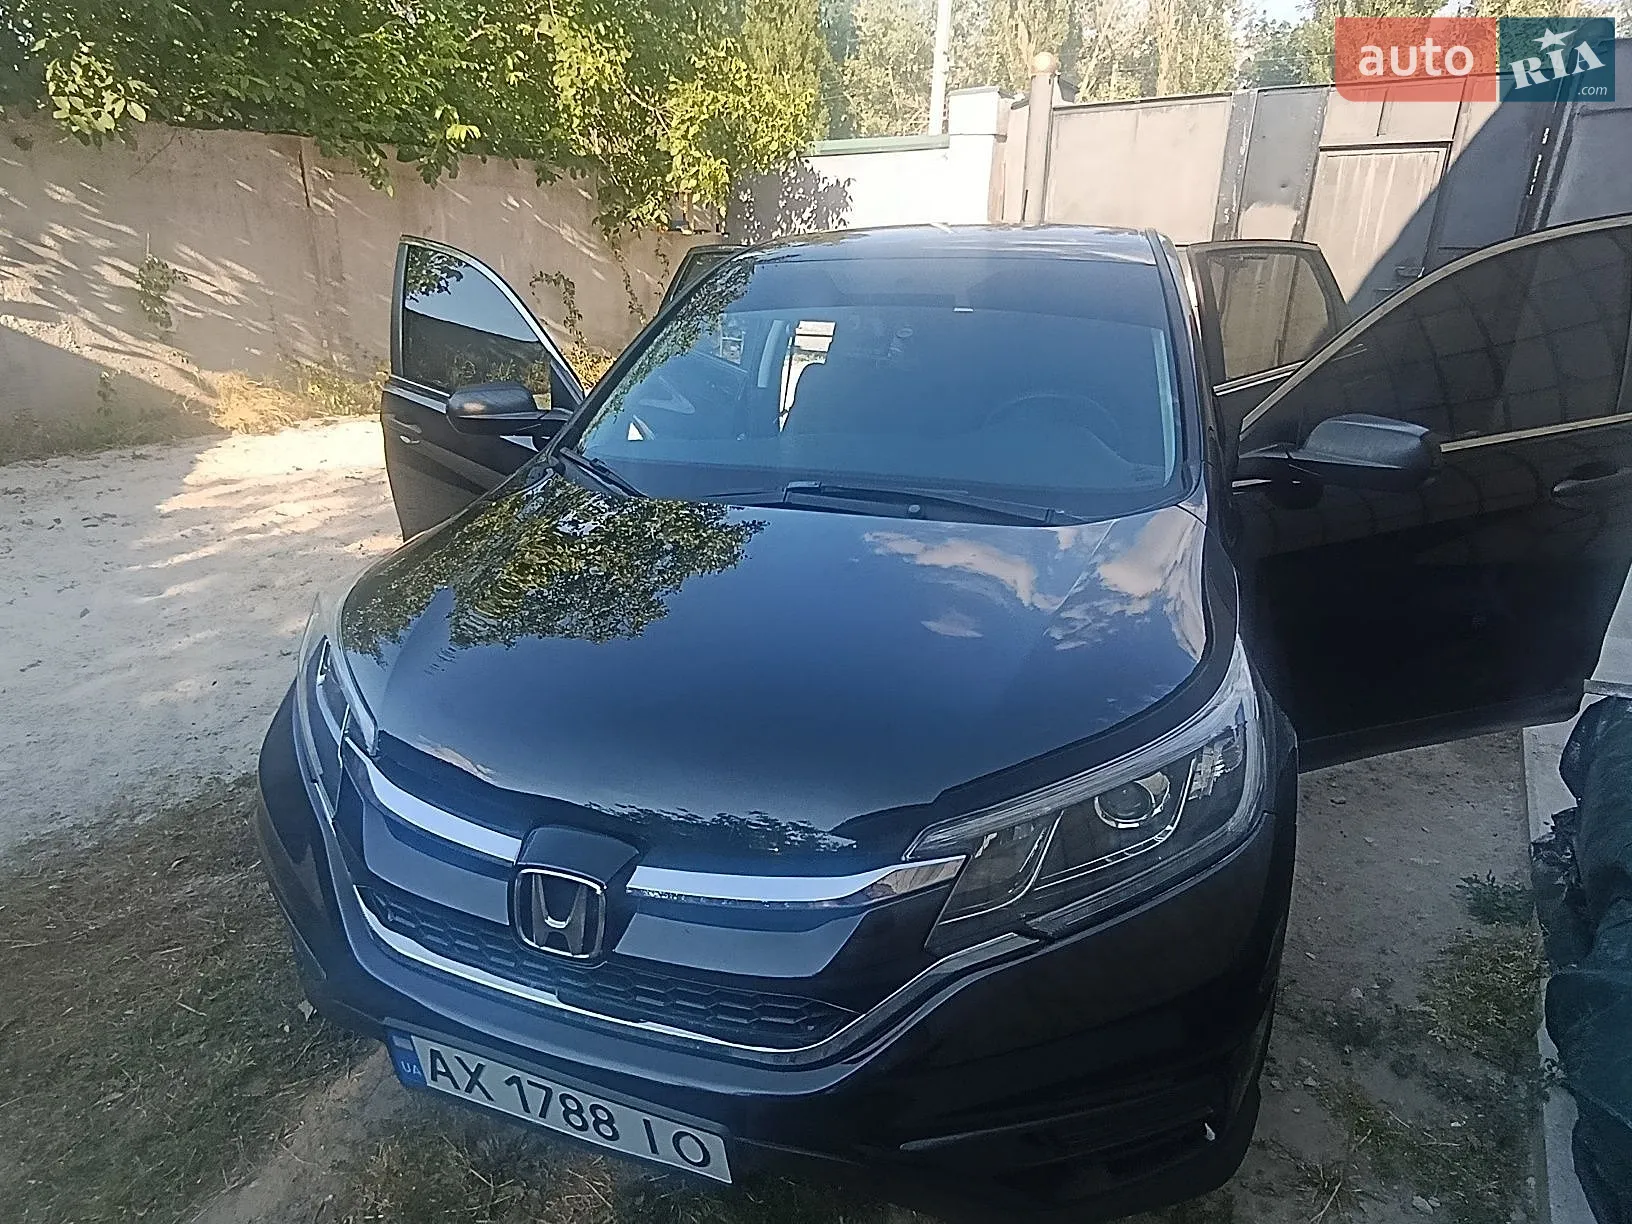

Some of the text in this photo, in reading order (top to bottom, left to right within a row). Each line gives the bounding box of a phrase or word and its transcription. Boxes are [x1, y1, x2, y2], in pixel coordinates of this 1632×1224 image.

[400, 1060, 423, 1077] UA
[429, 1048, 711, 1168] AX 1788 IO
